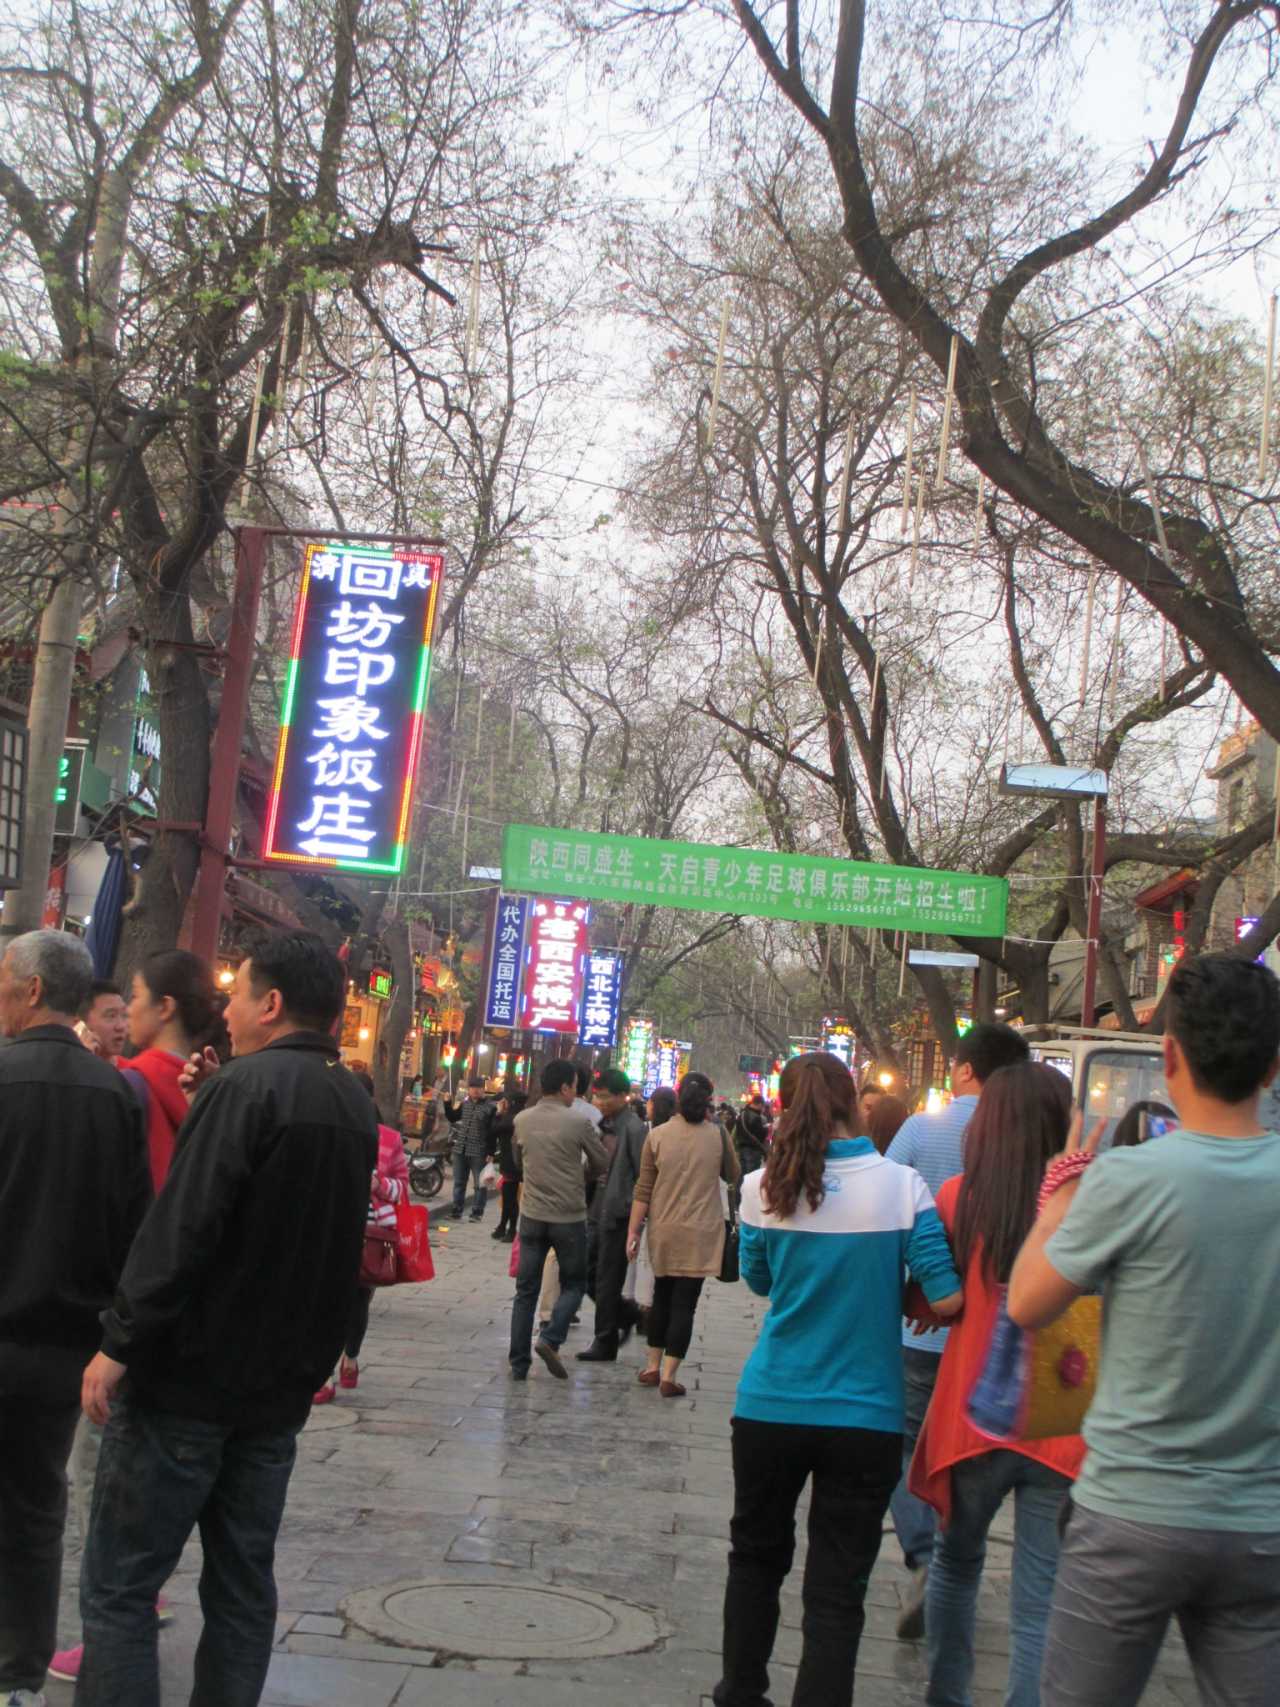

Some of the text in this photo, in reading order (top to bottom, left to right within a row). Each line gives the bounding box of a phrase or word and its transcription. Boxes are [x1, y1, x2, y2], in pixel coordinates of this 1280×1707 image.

[401, 562, 431, 589] 真
[297, 554, 405, 842] 回坊印象饭庄
[492, 905, 521, 1020] 代办全国托运
[530, 918, 579, 1027] 老西安特产
[583, 958, 616, 1041] 西北土特产
